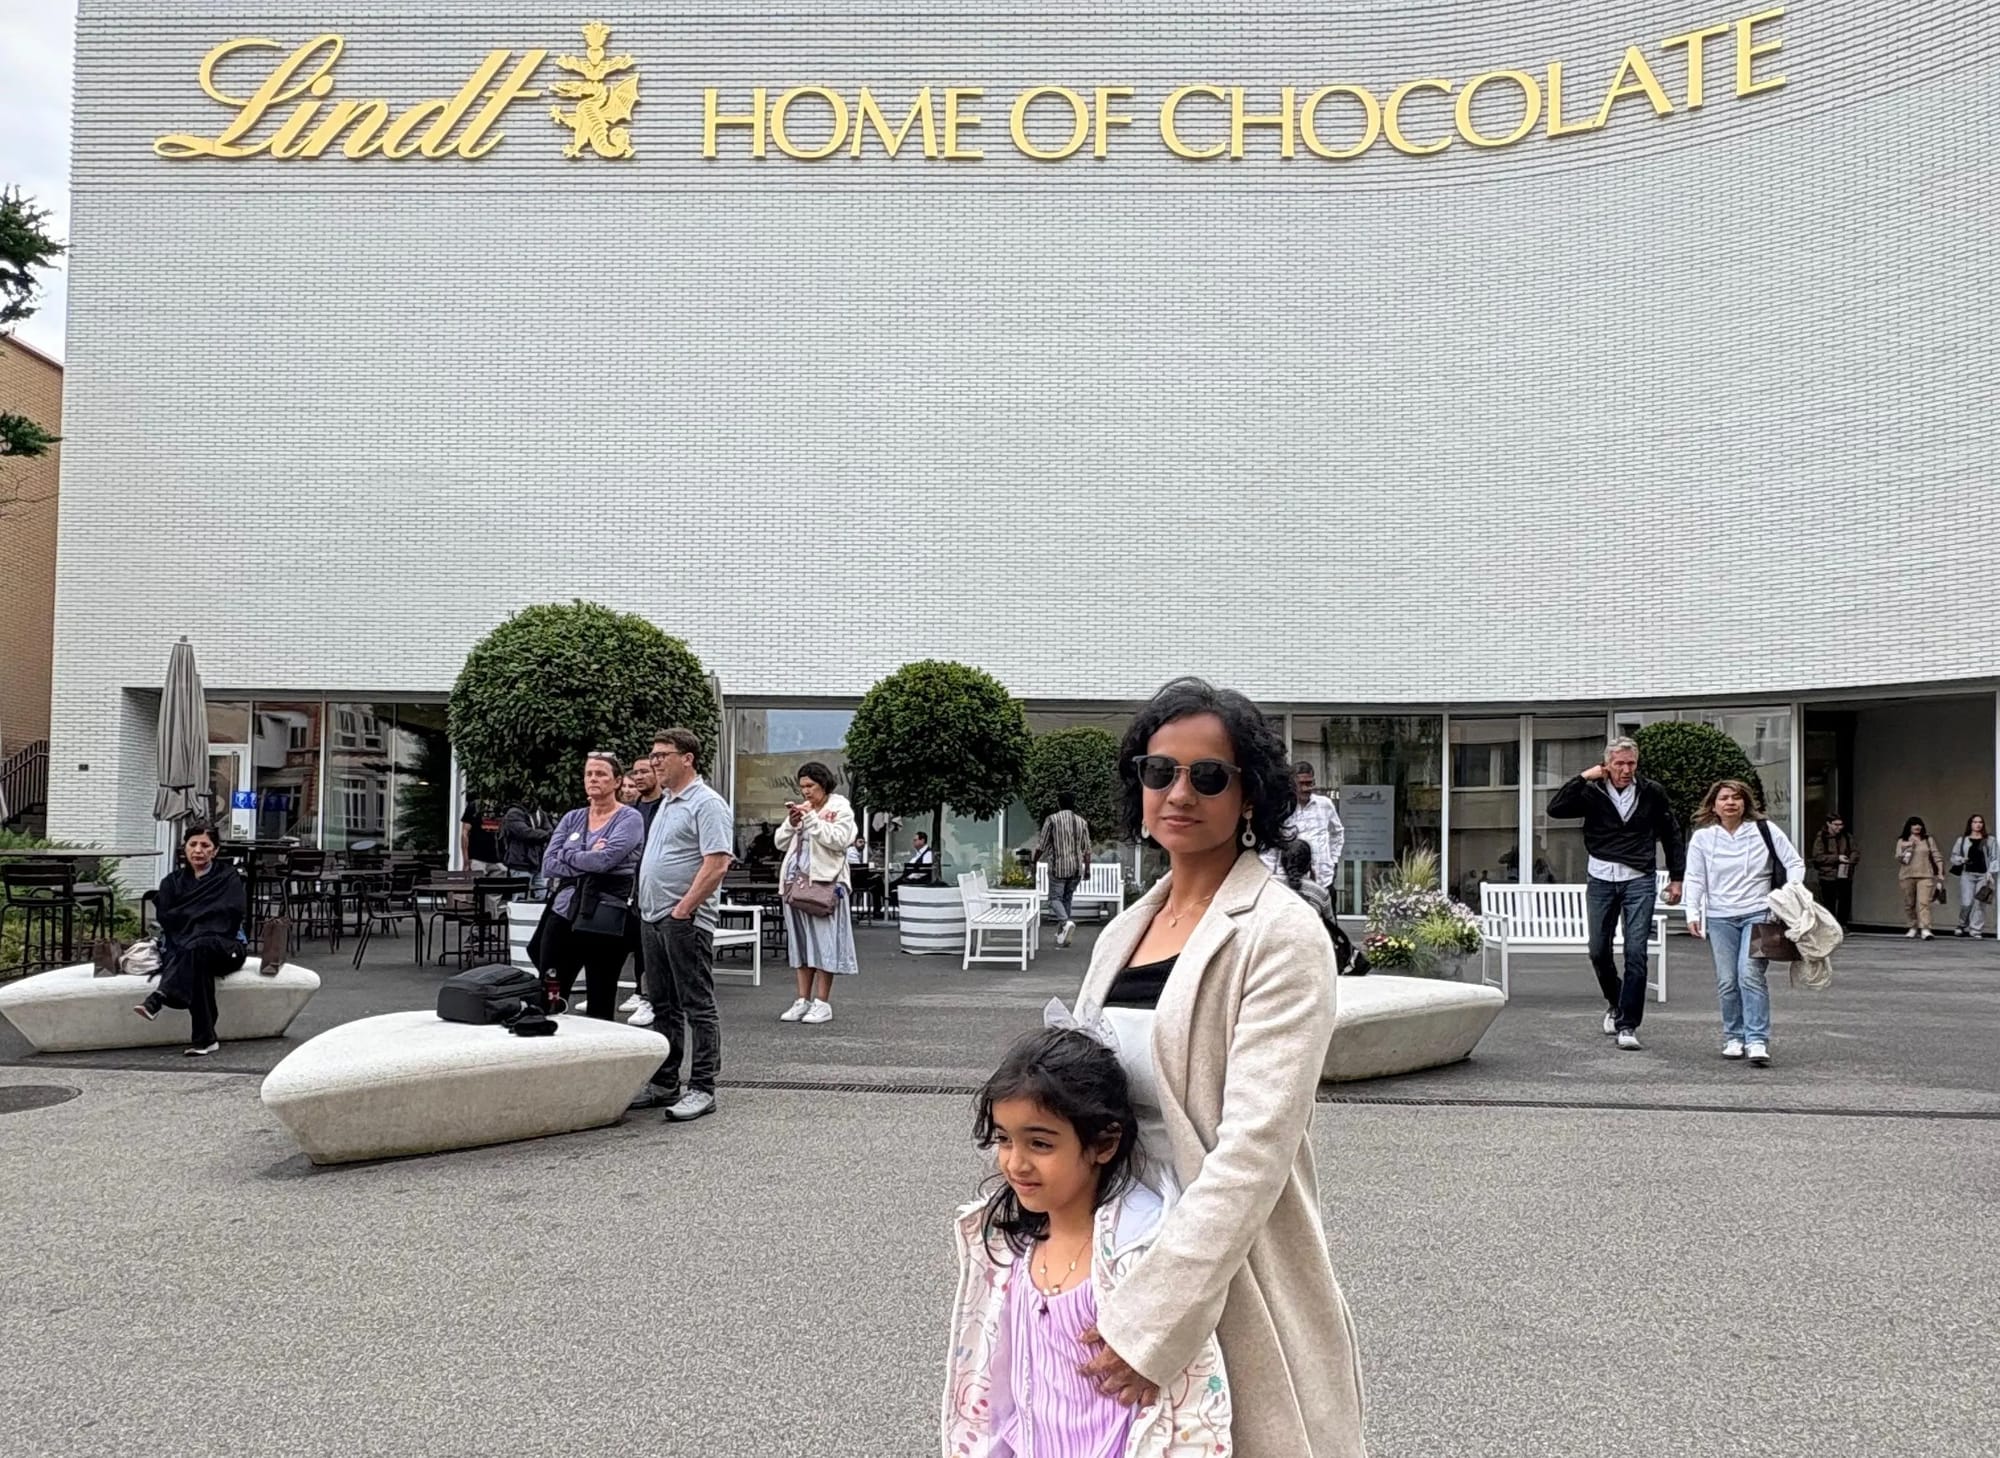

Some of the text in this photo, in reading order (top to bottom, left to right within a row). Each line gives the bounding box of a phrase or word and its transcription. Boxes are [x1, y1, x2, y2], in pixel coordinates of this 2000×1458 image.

[152, 33, 549, 160] Lindt
[702, 7, 1788, 159] HOME OF CHOCOLATE
